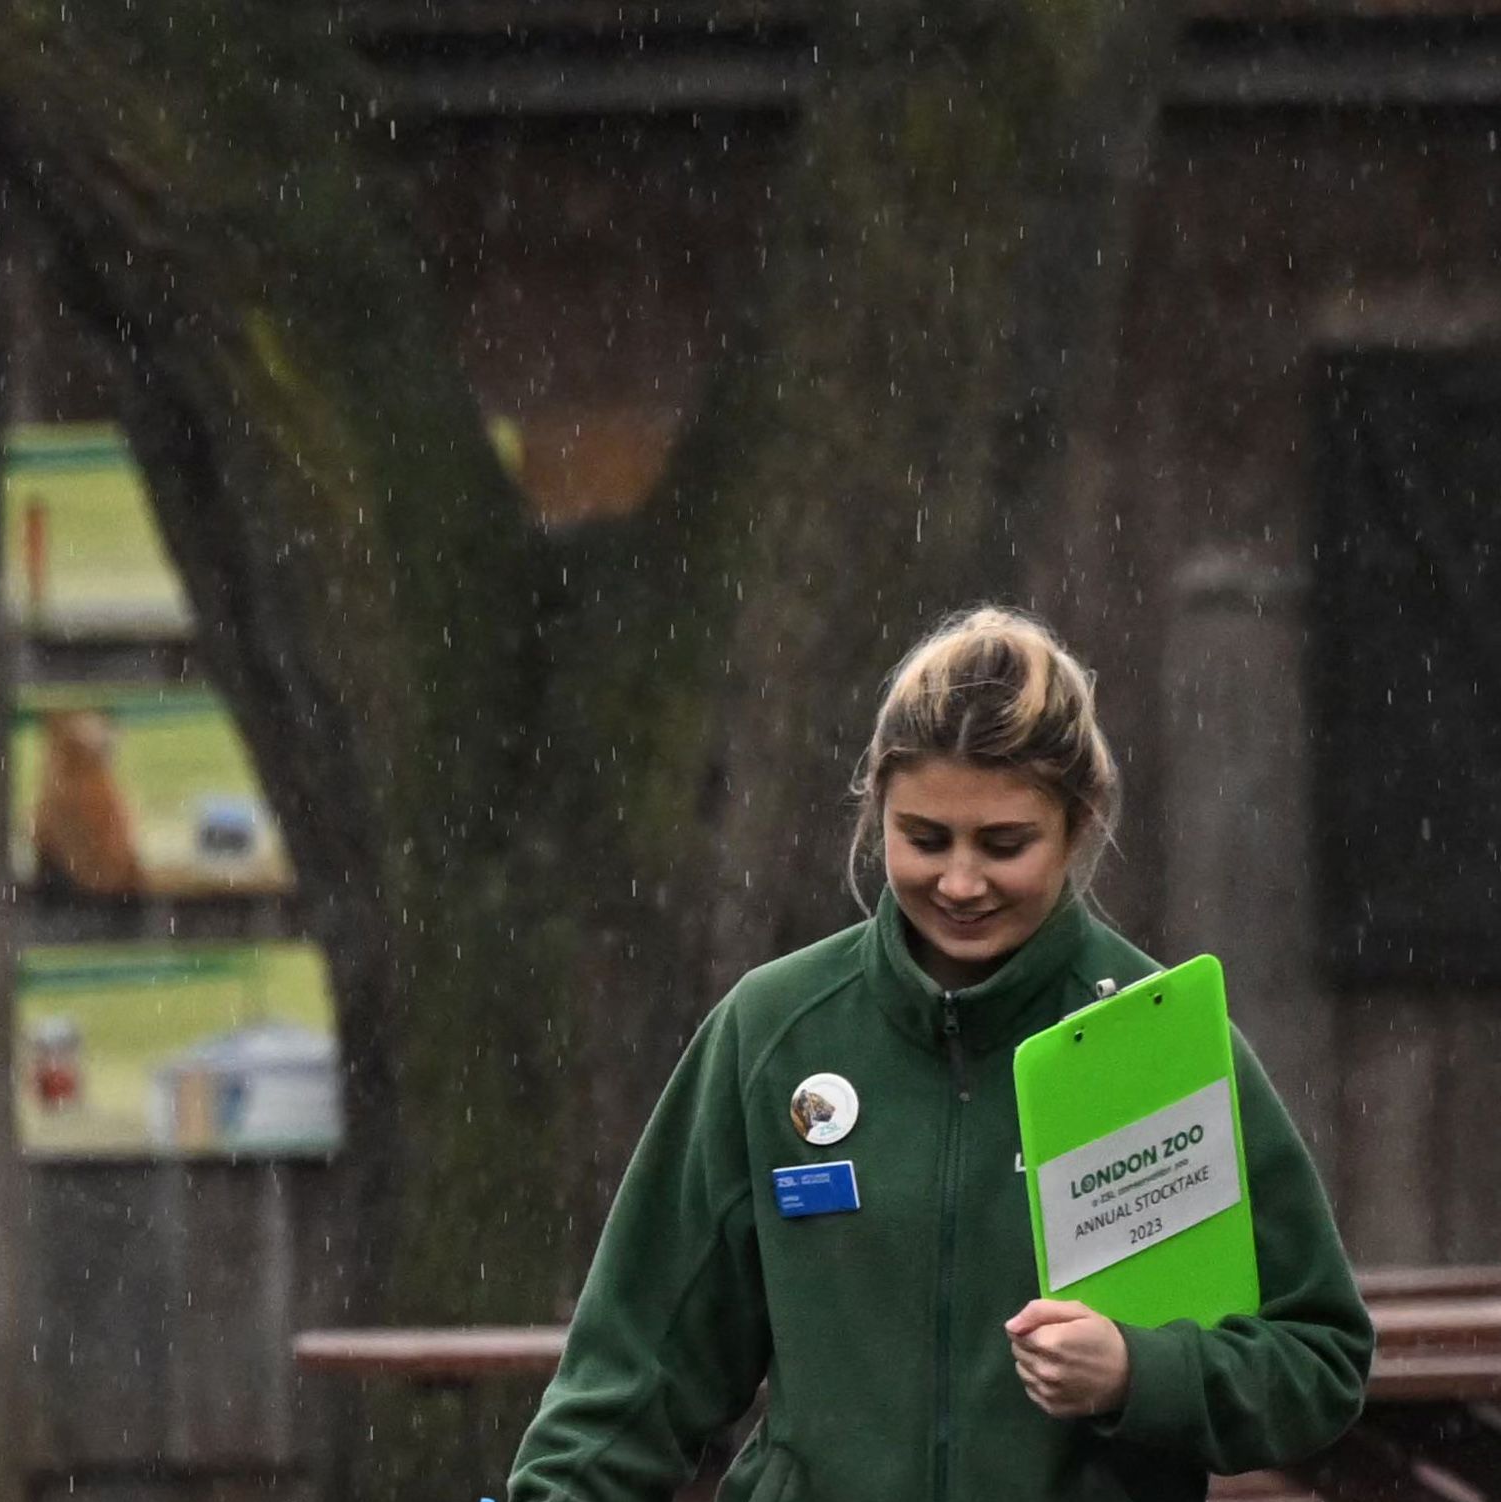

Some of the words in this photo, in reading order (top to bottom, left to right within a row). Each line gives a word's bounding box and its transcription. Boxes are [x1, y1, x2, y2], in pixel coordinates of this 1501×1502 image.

[1071, 1145, 1158, 1199] LONDON
[1162, 1124, 1204, 1158] ZOO
[1075, 1203, 1133, 1240] ANNUAL
[1135, 1165, 1211, 1213] STOCKTAKE
[1129, 1217, 1164, 1245] 2023
